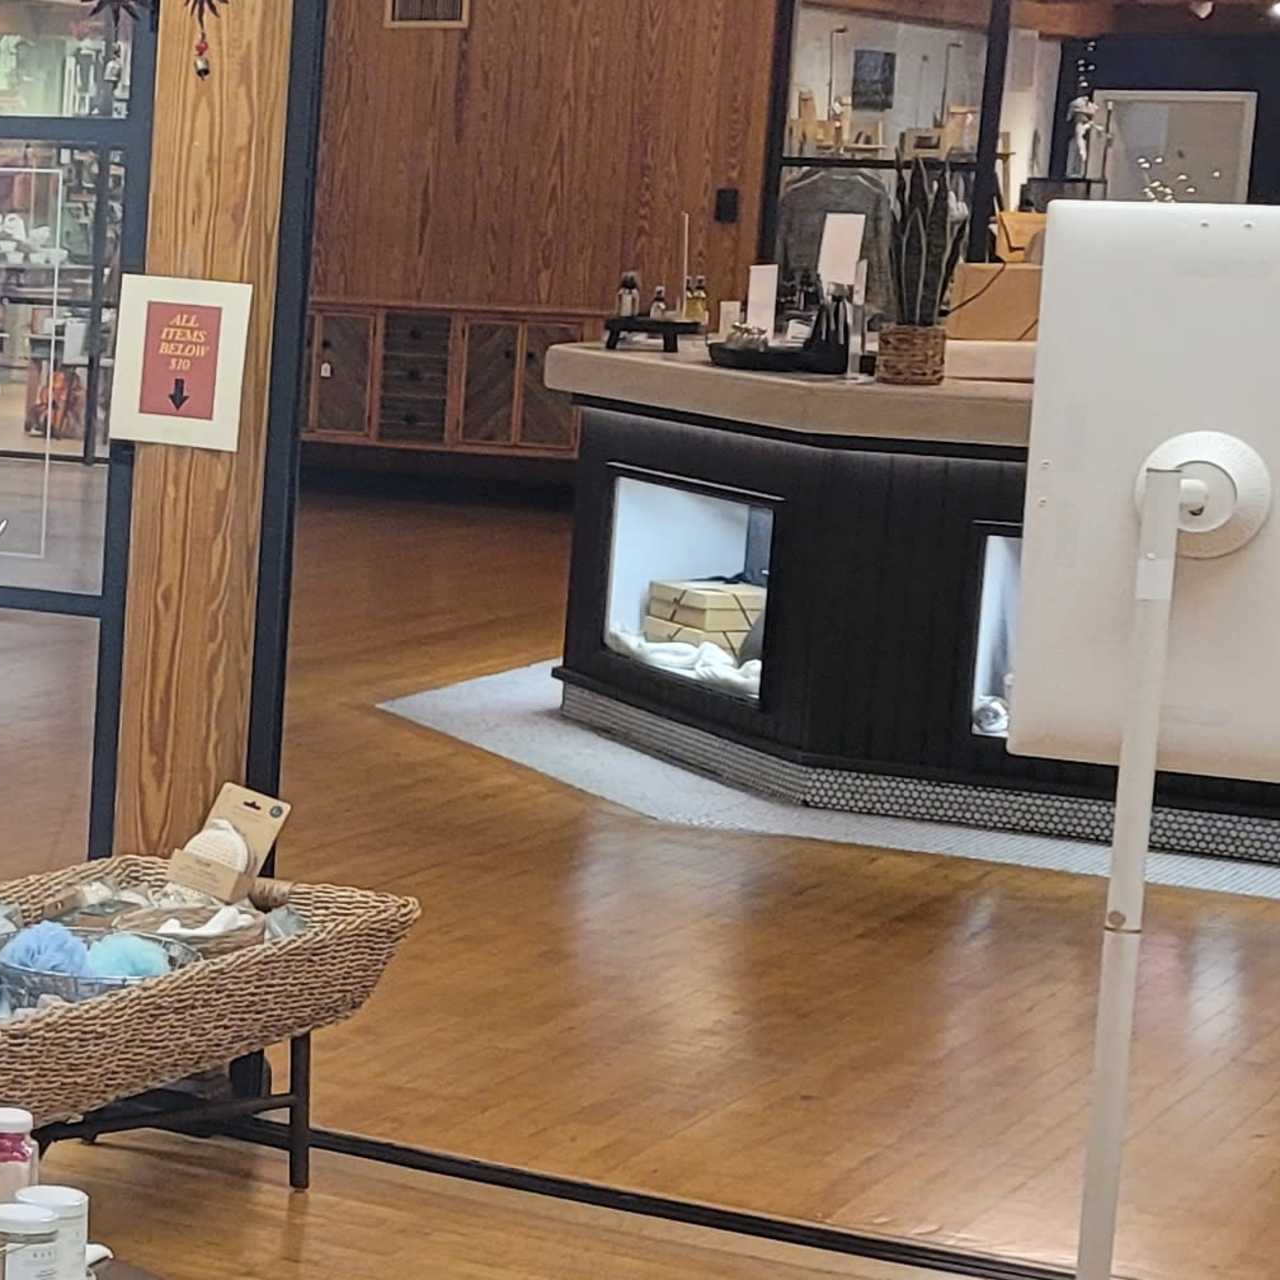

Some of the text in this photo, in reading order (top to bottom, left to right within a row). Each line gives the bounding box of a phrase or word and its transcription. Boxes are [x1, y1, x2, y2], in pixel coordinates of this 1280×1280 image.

[169, 313, 200, 328] ALL
[160, 327, 208, 344] ITEMS
[158, 340, 210, 359] BELOW
